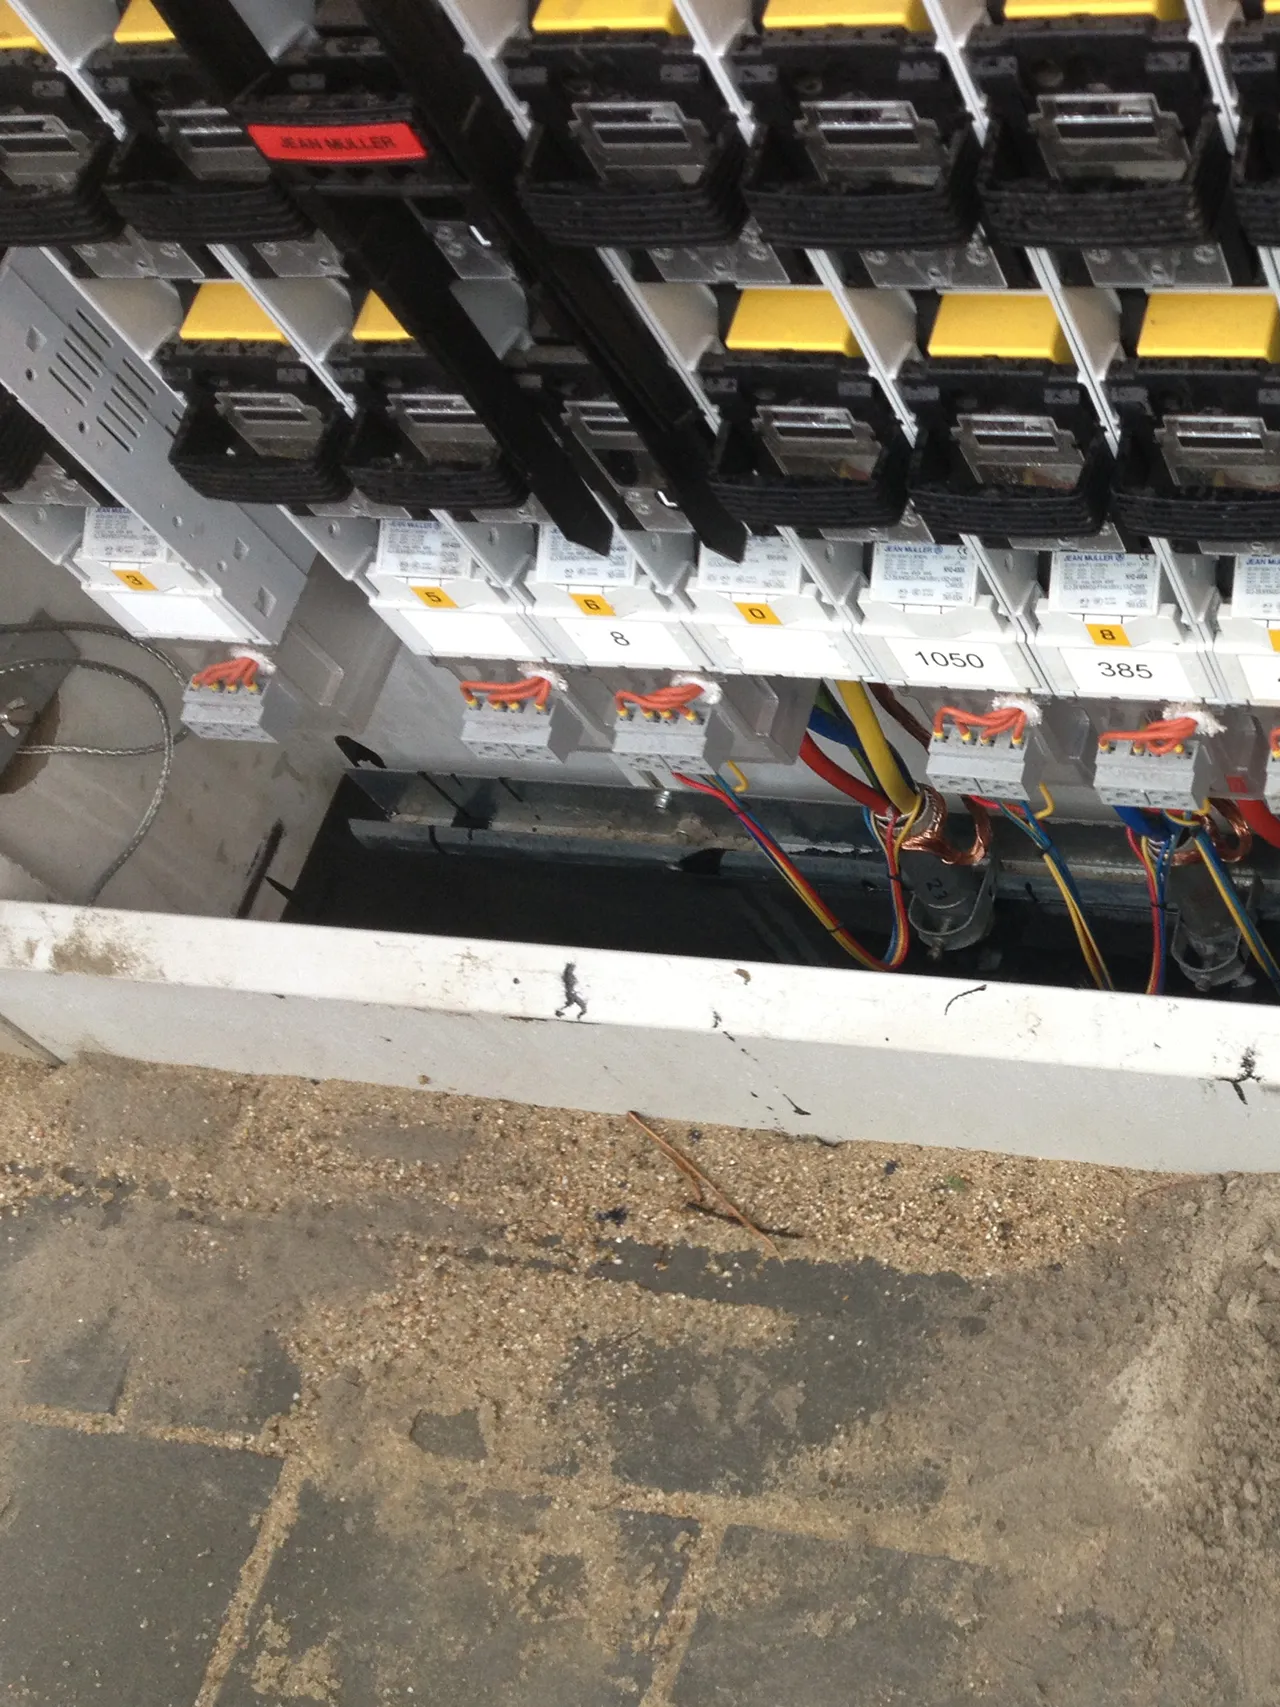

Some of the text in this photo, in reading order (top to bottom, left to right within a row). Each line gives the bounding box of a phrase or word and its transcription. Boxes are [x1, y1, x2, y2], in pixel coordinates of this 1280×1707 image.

[280, 136, 322, 149] JEAN
[1063, 553, 1083, 562] JEAN
[1246, 558, 1267, 566] JEAN
[126, 574, 143, 586] 3
[425, 592, 442, 603] 5
[584, 599, 601, 611] 6
[610, 631, 630, 646] 8
[1100, 628, 1116, 641] 8
[915, 651, 985, 669] 1050
[1097, 661, 1153, 679] 385
